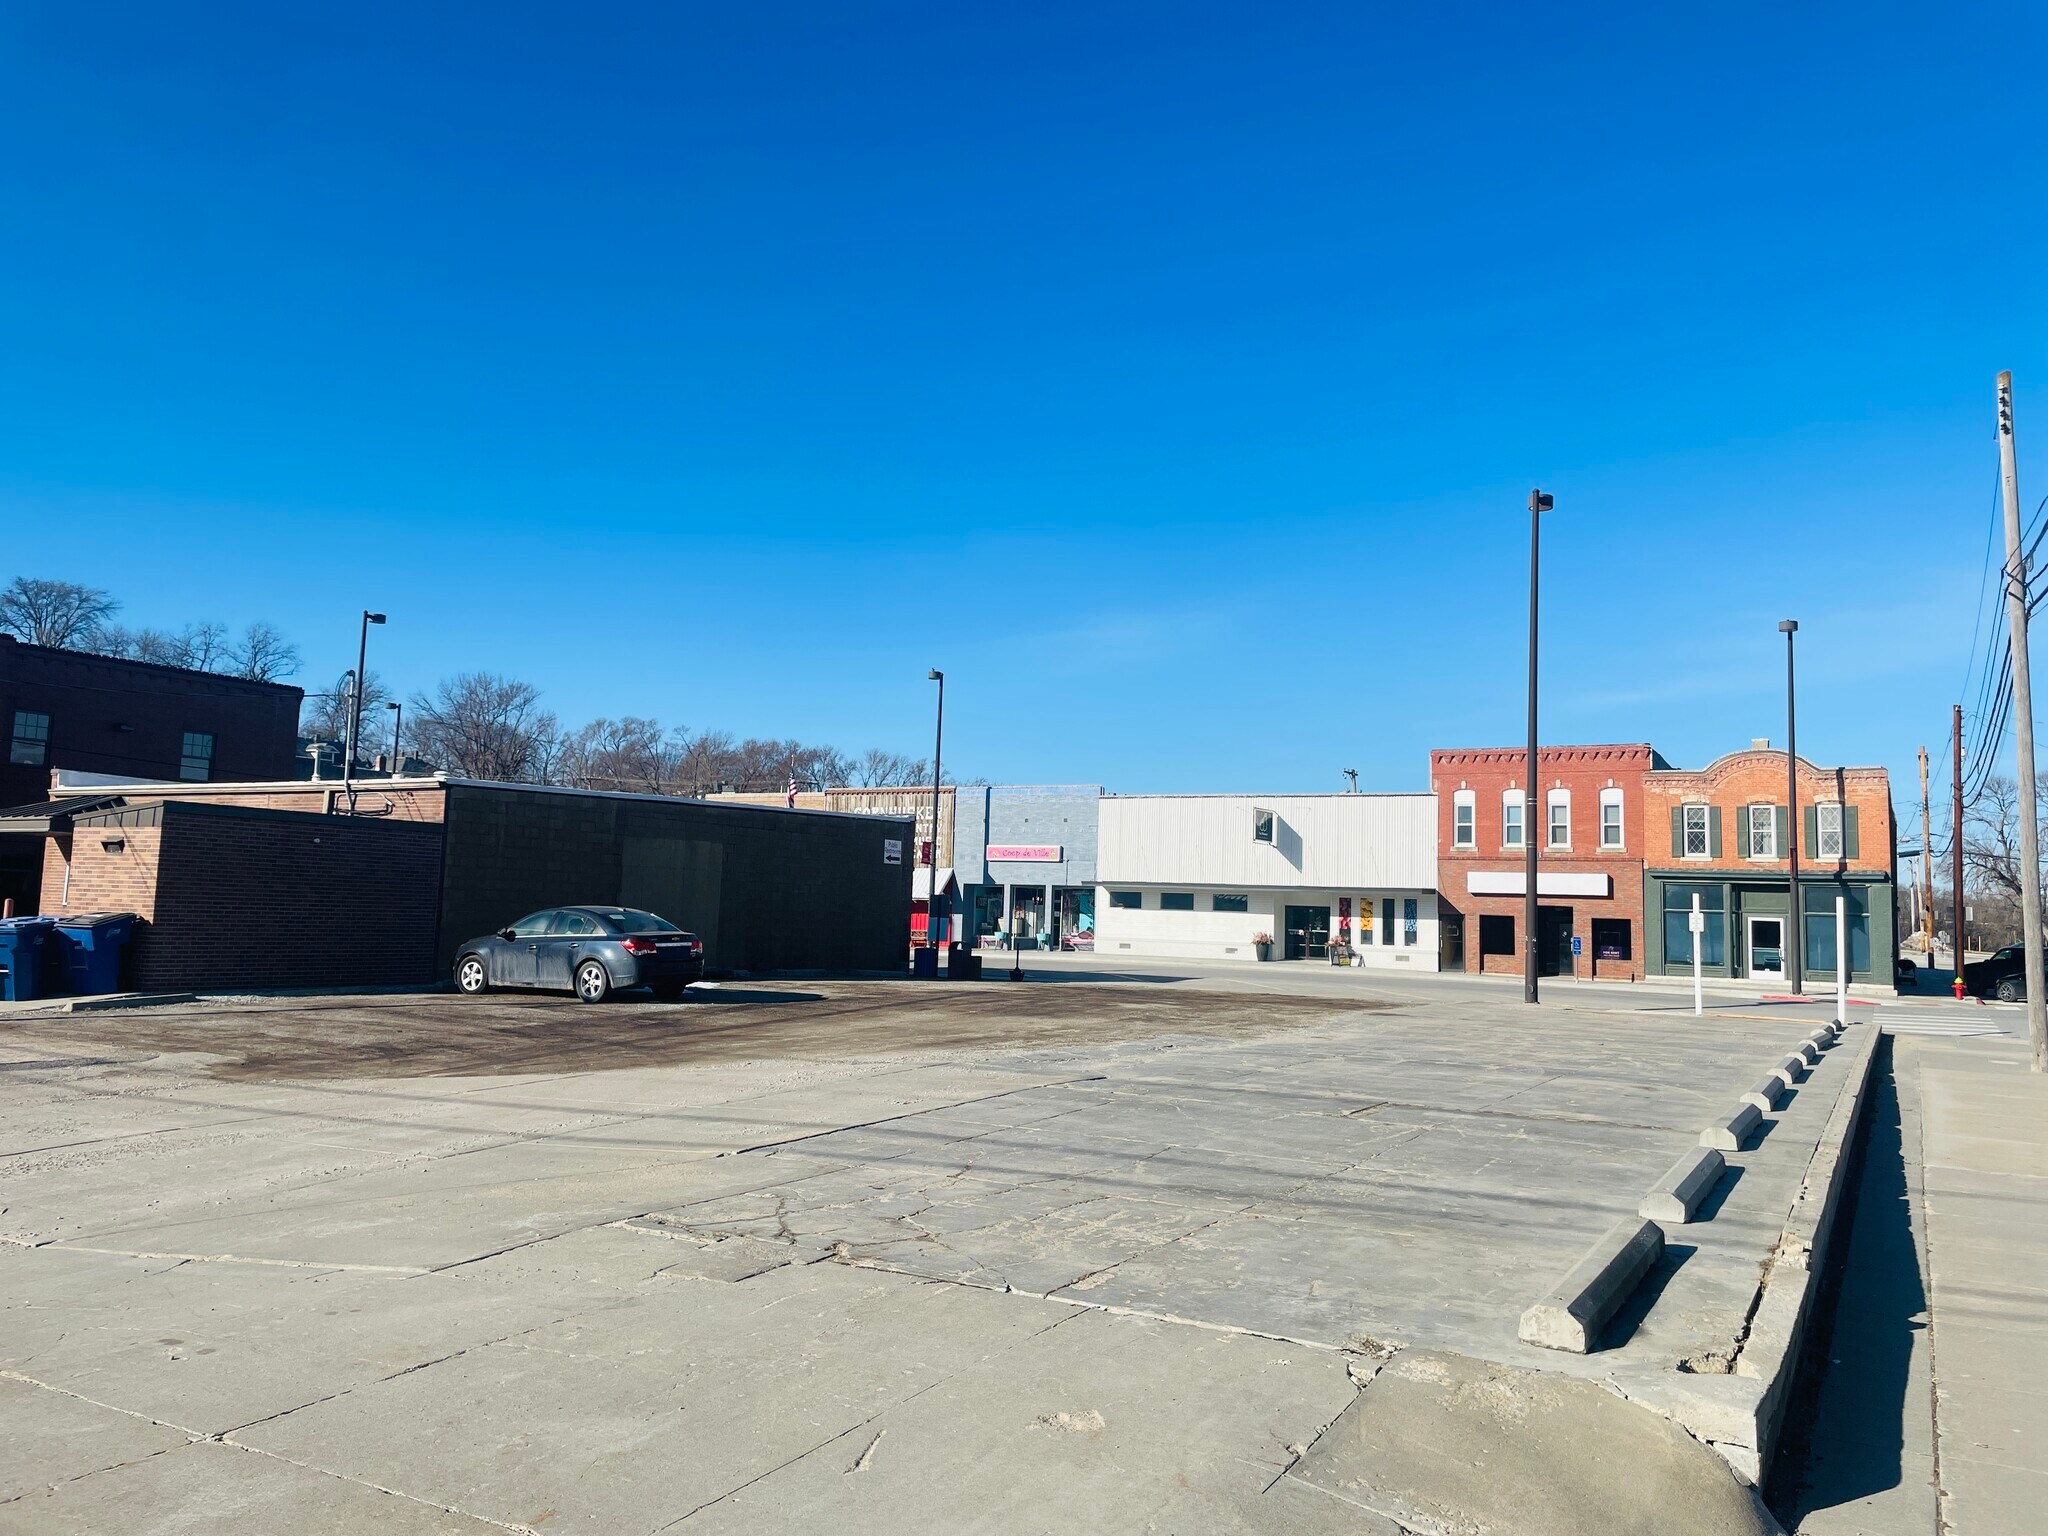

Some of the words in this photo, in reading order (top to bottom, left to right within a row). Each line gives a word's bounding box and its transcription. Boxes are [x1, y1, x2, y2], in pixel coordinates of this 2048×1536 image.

[1002, 849, 1020, 858] Coop
[1023, 848, 1031, 857] de
[1033, 848, 1049, 857] Ville
